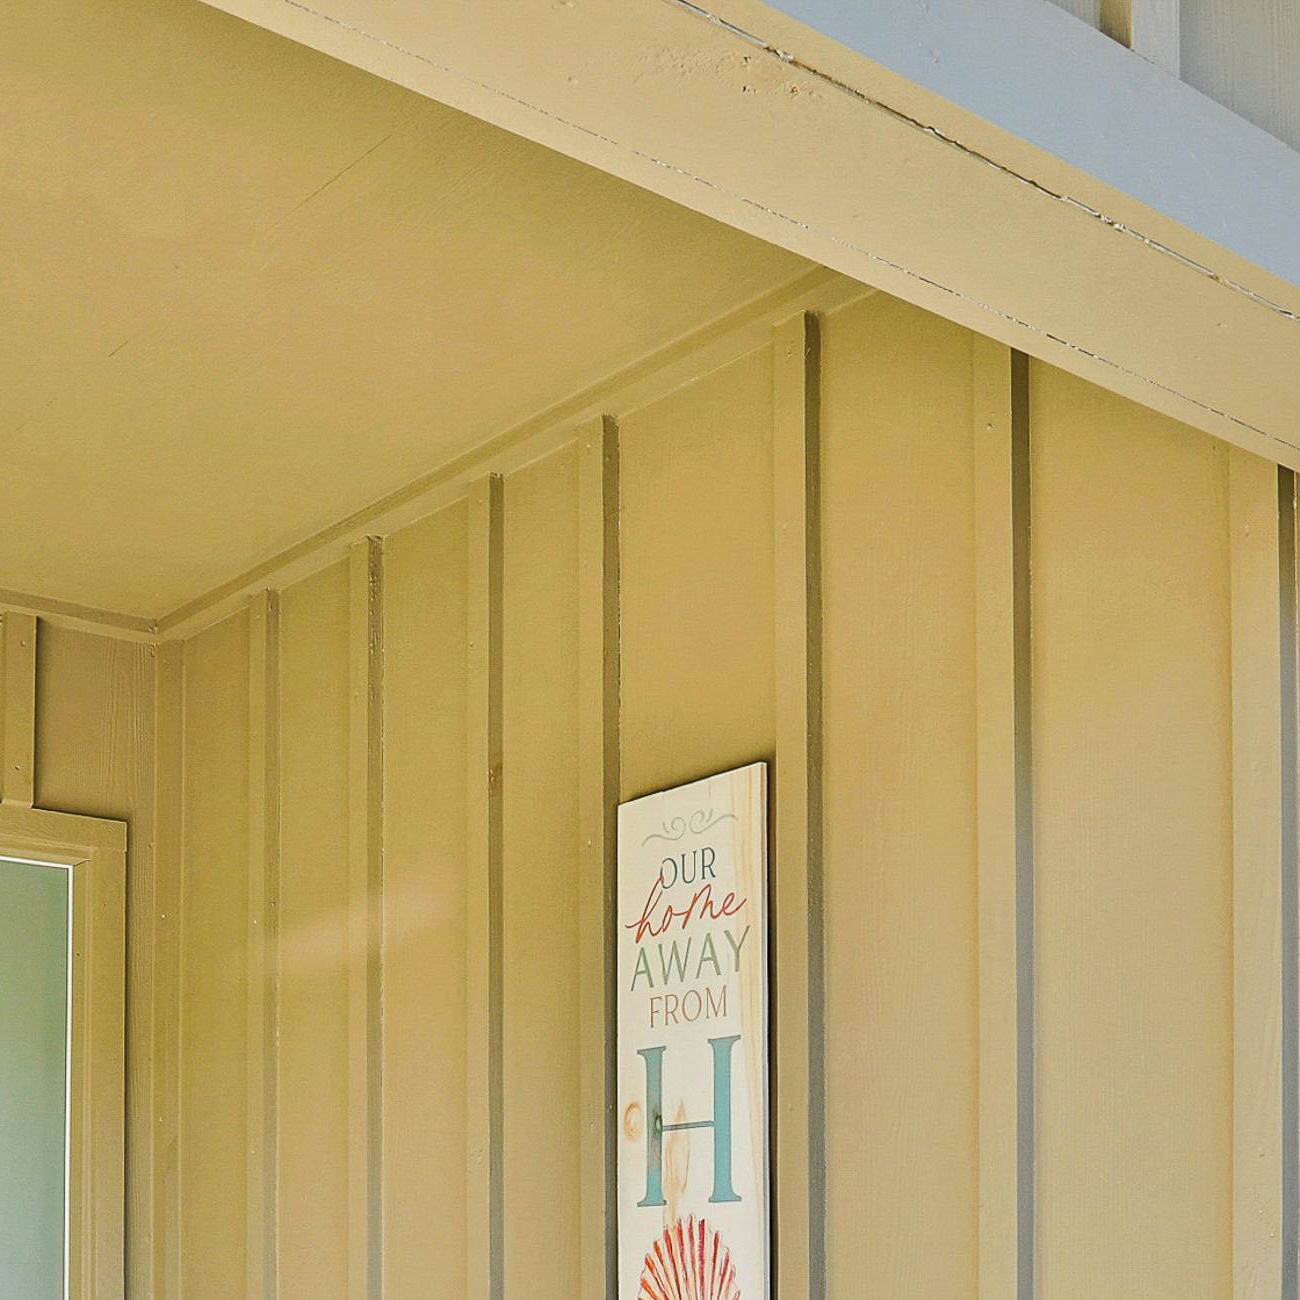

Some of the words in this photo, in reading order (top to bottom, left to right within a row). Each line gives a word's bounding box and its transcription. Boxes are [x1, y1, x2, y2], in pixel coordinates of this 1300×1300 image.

[660, 846, 716, 889] OUR
[625, 876, 747, 943] home
[630, 925, 750, 991] AWAY
[650, 986, 727, 1028] FROM
